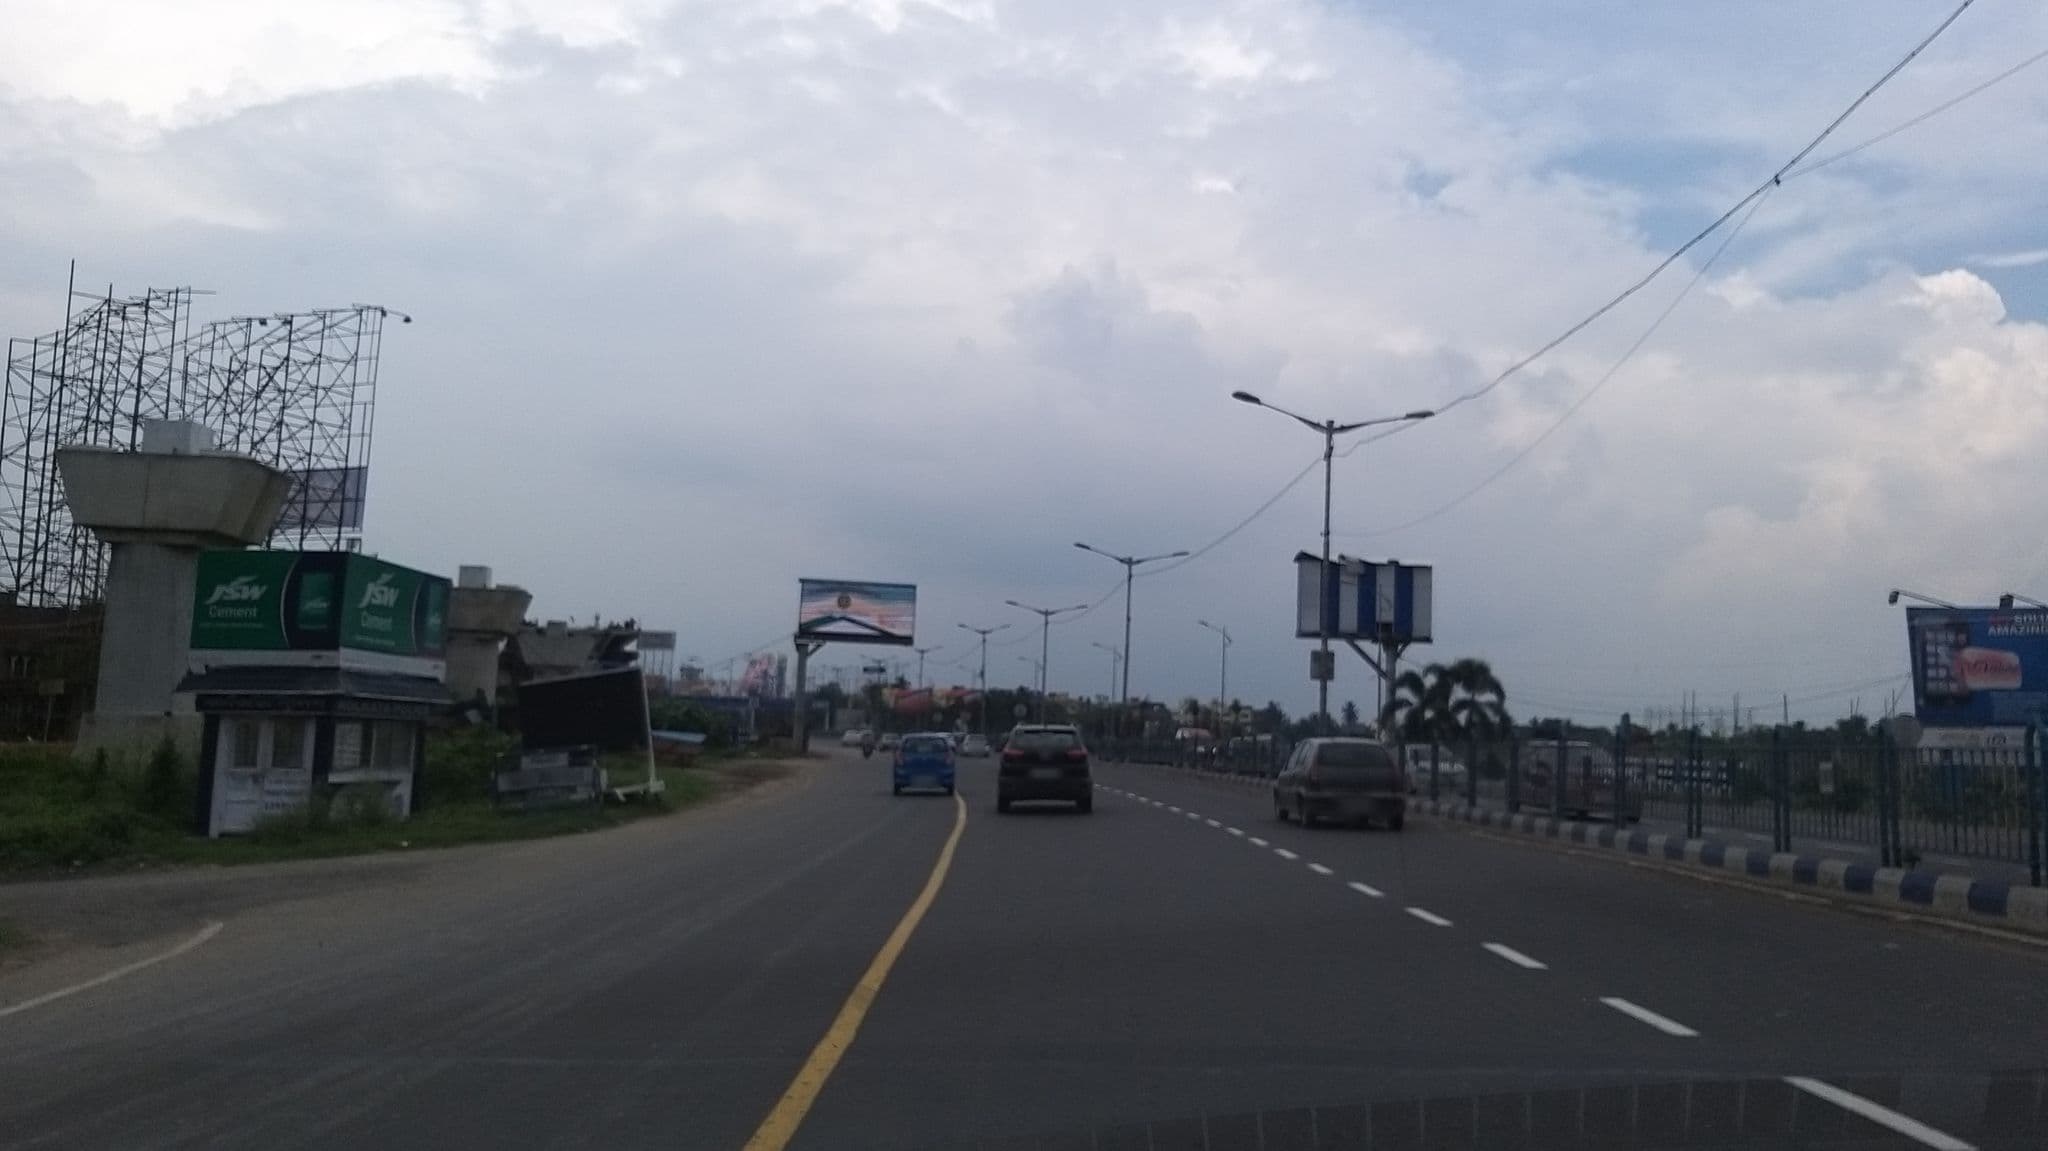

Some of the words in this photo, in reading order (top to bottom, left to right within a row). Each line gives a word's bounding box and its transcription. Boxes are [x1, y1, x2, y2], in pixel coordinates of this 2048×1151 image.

[205, 577, 267, 605] JSW
[358, 574, 399, 608] JSW
[208, 605, 258, 619] Cement
